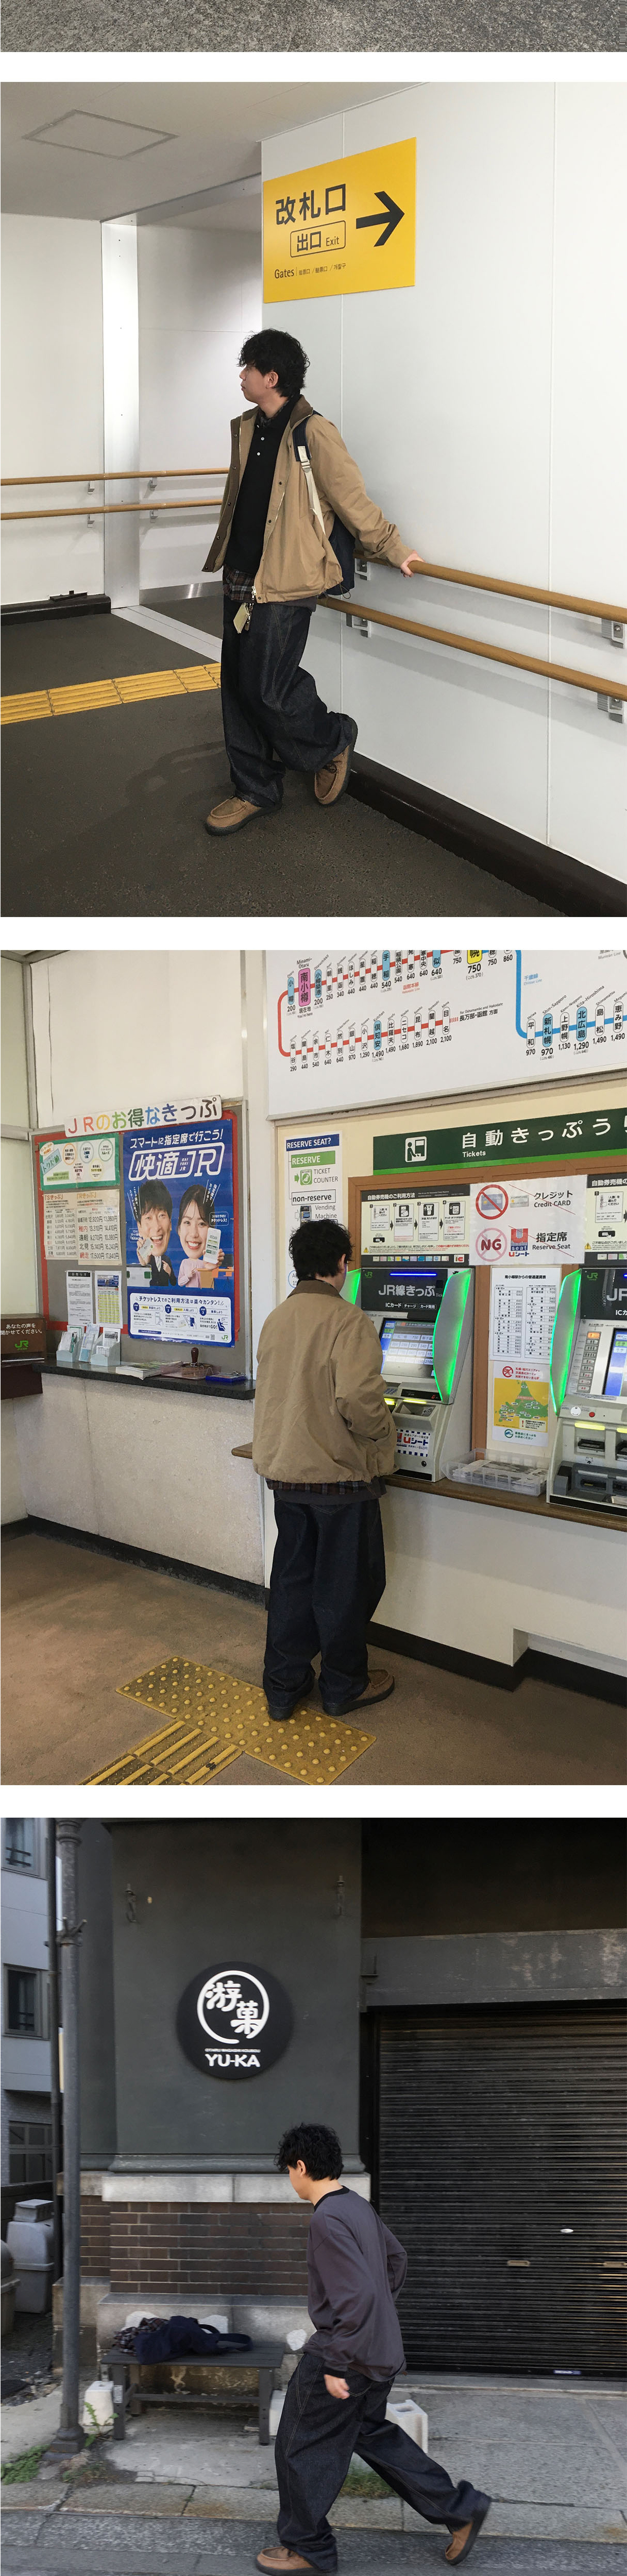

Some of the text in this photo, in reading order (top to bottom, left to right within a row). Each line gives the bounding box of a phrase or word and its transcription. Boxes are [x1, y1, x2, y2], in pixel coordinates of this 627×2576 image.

[276, 183, 346, 225] 改札口
[297, 231, 340, 252] 出口 Exit
[275, 268, 295, 279] Gates
[383, 954, 389, 978] 手稲
[468, 964, 481, 974] 750
[300, 972, 309, 1003] 南小樽
[576, 985, 605, 1008] Kita-Hiroshima
[543, 995, 567, 1015] Shin-Sapporo
[560, 995, 583, 1013] Kami-Nopporo
[596, 991, 615, 1006] Shimamatsu
[415, 1016, 421, 1038] 昆布
[443, 1010, 449, 1032] 目名
[578, 1011, 586, 1038] 北広島
[596, 1009, 603, 1033] 島松
[614, 1005, 622, 1030] 恵み野
[362, 1028, 367, 1049] 小沢
[528, 1022, 534, 1046] 平和
[544, 1017, 552, 1044] 新札幌
[592, 1036, 606, 1044] 1,490
[611, 1033, 625, 1041] 1,490
[314, 1039, 318, 1058] 余市
[326, 1037, 331, 1056] 仁木
[350, 1031, 355, 1051] 銀山
[573, 1041, 589, 1050] 1,290
[68, 1097, 217, 1134] JRのお得なきっぷ
[287, 1138, 331, 1149] RESERVE SEAT?
[292, 1156, 321, 1165] RESERVE
[293, 1194, 332, 1202] non-reserve
[367, 1192, 415, 1200] 自動券売機のご利用方法
[534, 1190, 573, 1200] クレジット
[481, 1239, 502, 1250] NG
[536, 1232, 568, 1242] 指定席
[378, 1284, 435, 1297] JR線きっぷ
[205, 2054, 261, 2067] YU-KA
